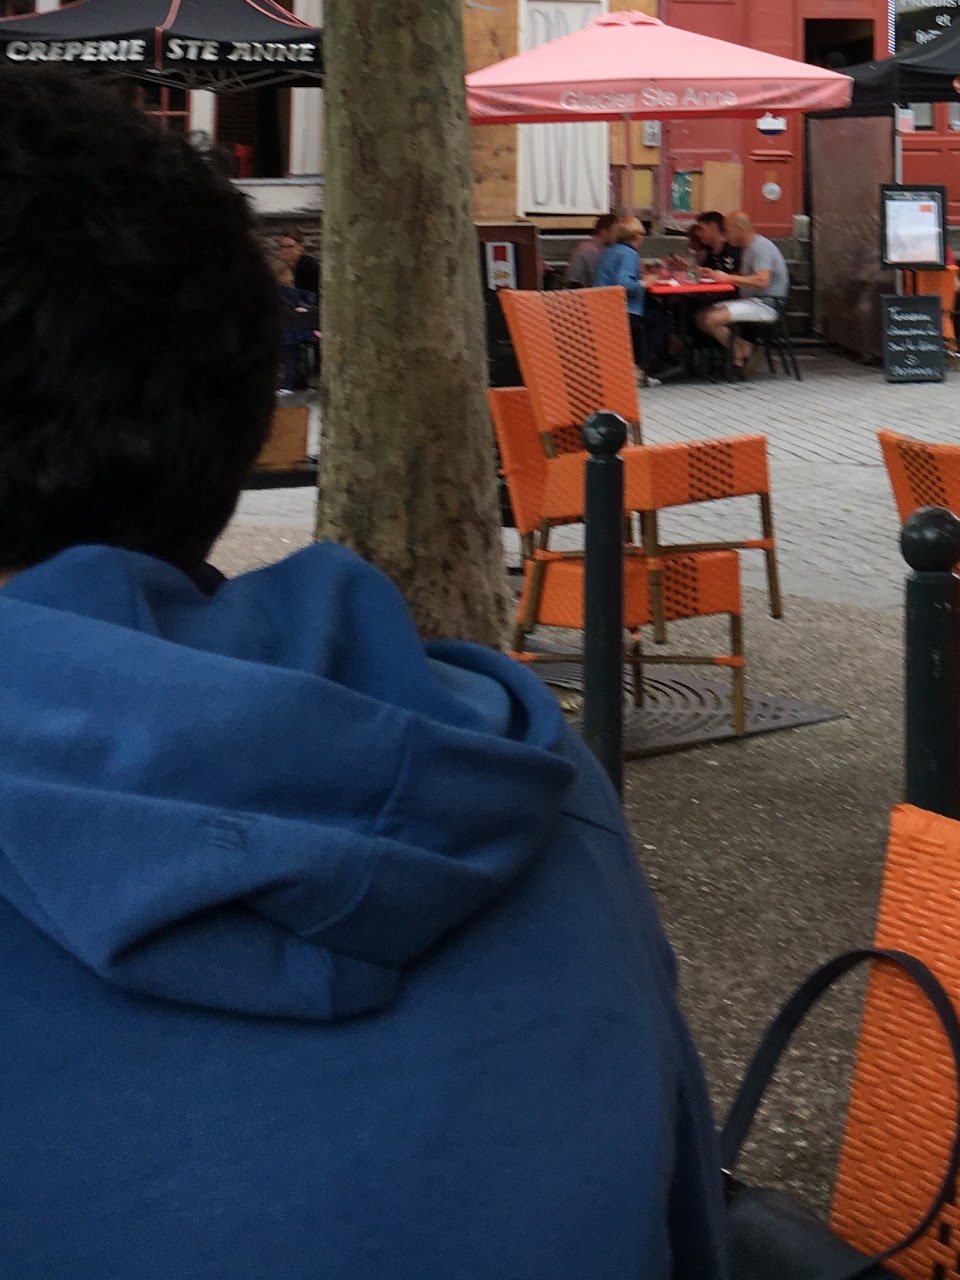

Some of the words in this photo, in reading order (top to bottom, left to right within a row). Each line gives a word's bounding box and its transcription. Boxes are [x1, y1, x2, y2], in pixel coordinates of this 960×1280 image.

[6, 39, 147, 61] CREPERIE
[166, 38, 220, 60] STE
[226, 42, 316, 62] ANNE
[559, 88, 636, 110] Glacier
[641, 86, 678, 107] Ste
[682, 86, 738, 107] Anne
